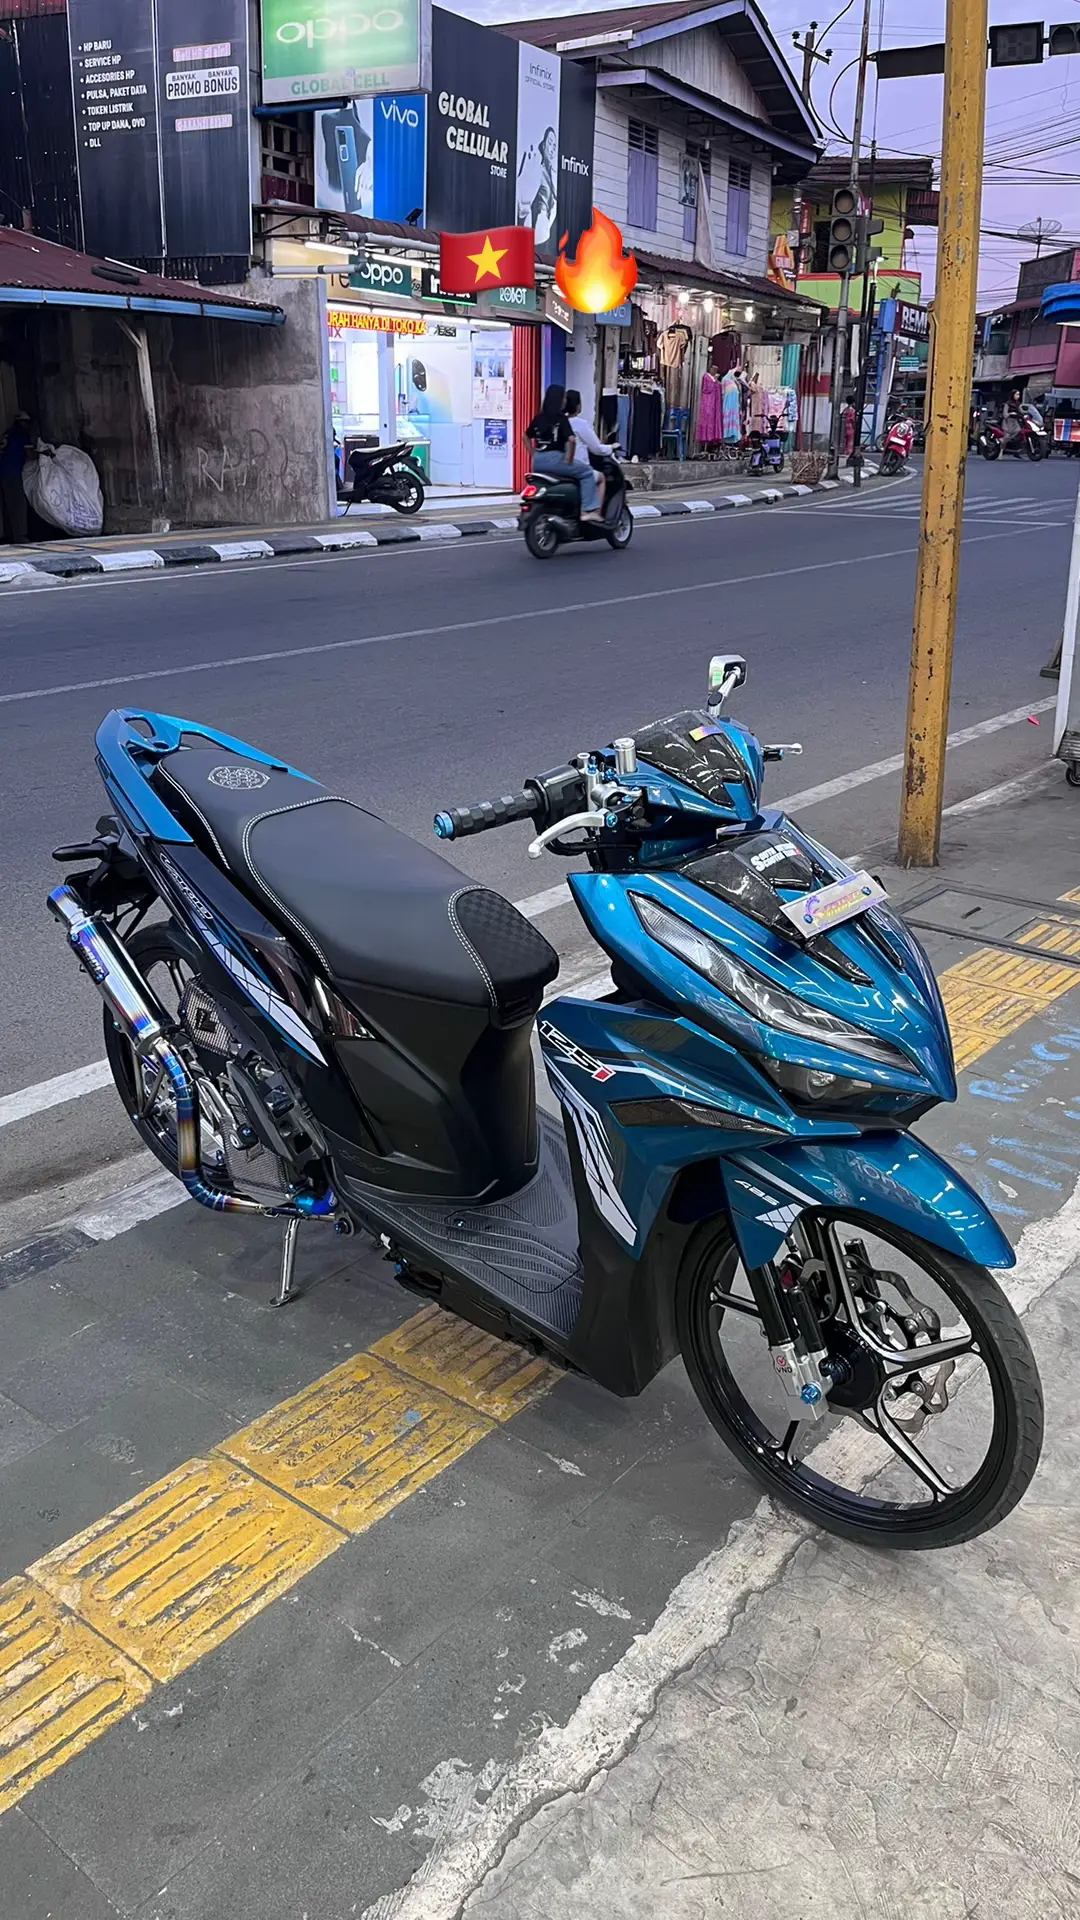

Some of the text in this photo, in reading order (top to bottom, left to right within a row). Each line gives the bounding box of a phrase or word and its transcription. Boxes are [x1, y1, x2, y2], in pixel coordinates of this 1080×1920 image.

[276, 9, 404, 49] oppo
[84, 40, 112, 52] HP BARU
[84, 55, 121, 68] SERVICE HP
[86, 70, 135, 84] ACCESORIES HP
[172, 69, 232, 81] BANYAK BANYAK
[530, 62, 552, 80] Infinix
[86, 85, 147, 100] PULSA, PAKET DATA
[168, 77, 238, 97] PROMO BONUS
[291, 72, 390, 95] GLOBAL CELL
[87, 102, 134, 116] TOKEN LISTRIK
[380, 100, 418, 127] vivo
[438, 91, 490, 128] GLOBAL
[88, 118, 146, 131] TOP UP DANA, OVO
[90, 138, 101, 148] DLL
[446, 126, 508, 164] CELLULAR
[490, 165, 507, 178] STORE
[562, 155, 588, 176] Infinix
[352, 313, 380, 330] HANYA
[382, 318, 390, 331] DI
[392, 319, 414, 333] TOKO
[539, 1020, 616, 1082] 125i
